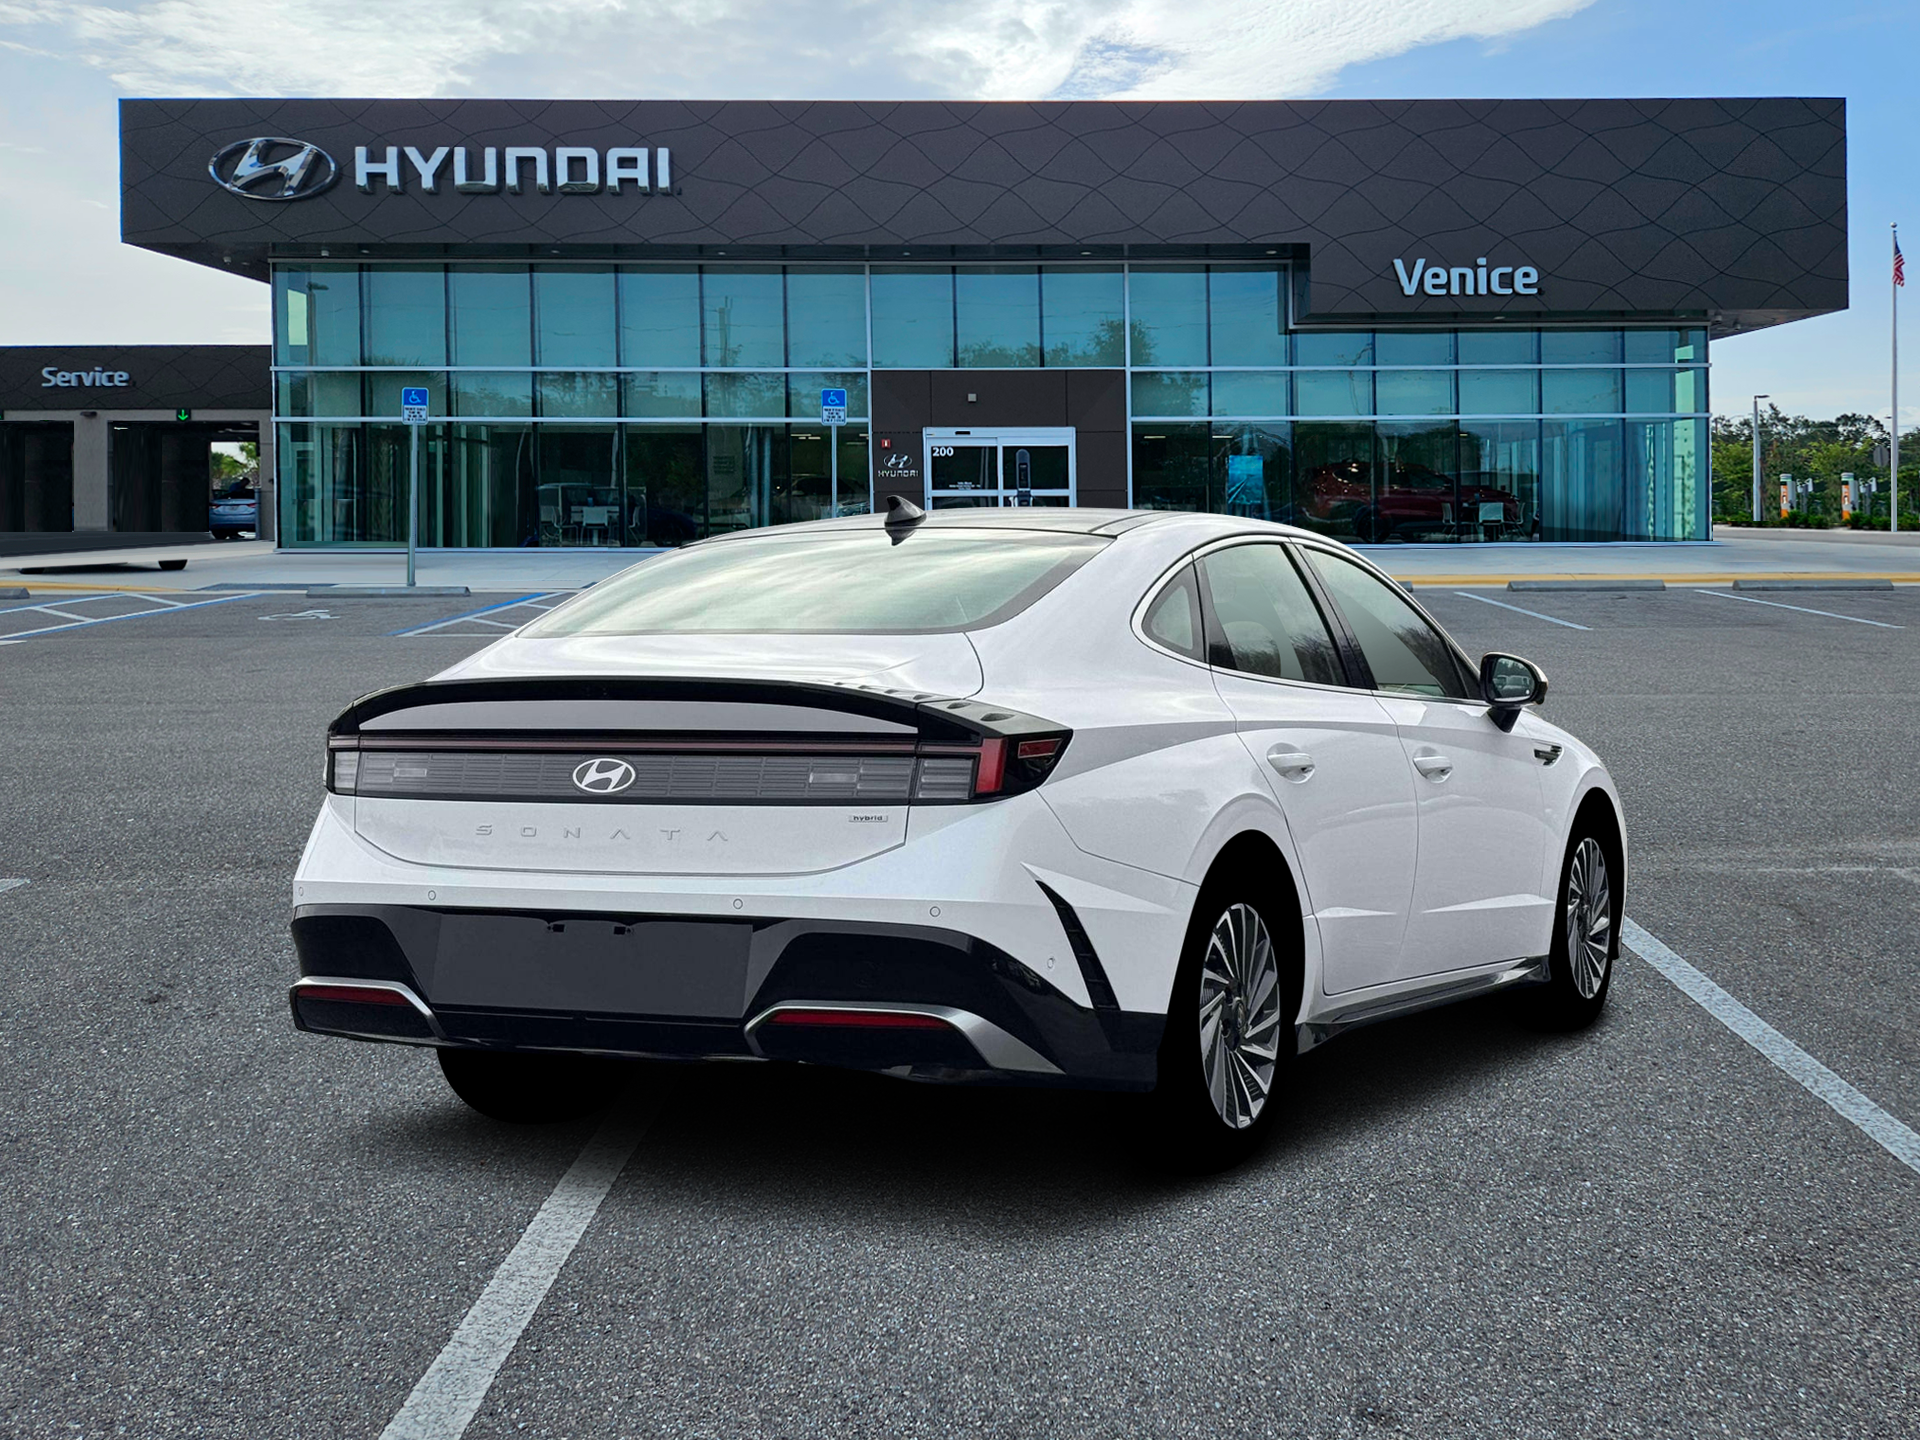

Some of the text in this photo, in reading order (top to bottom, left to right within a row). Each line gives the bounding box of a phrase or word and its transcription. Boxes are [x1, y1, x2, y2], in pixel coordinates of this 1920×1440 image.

[355, 146, 671, 193] HYUNDAI
[1393, 257, 1539, 296] Venice
[41, 366, 130, 387] Service
[932, 446, 955, 457] 200
[878, 470, 919, 478] HYUNDAI
[475, 824, 729, 842] SONATA
